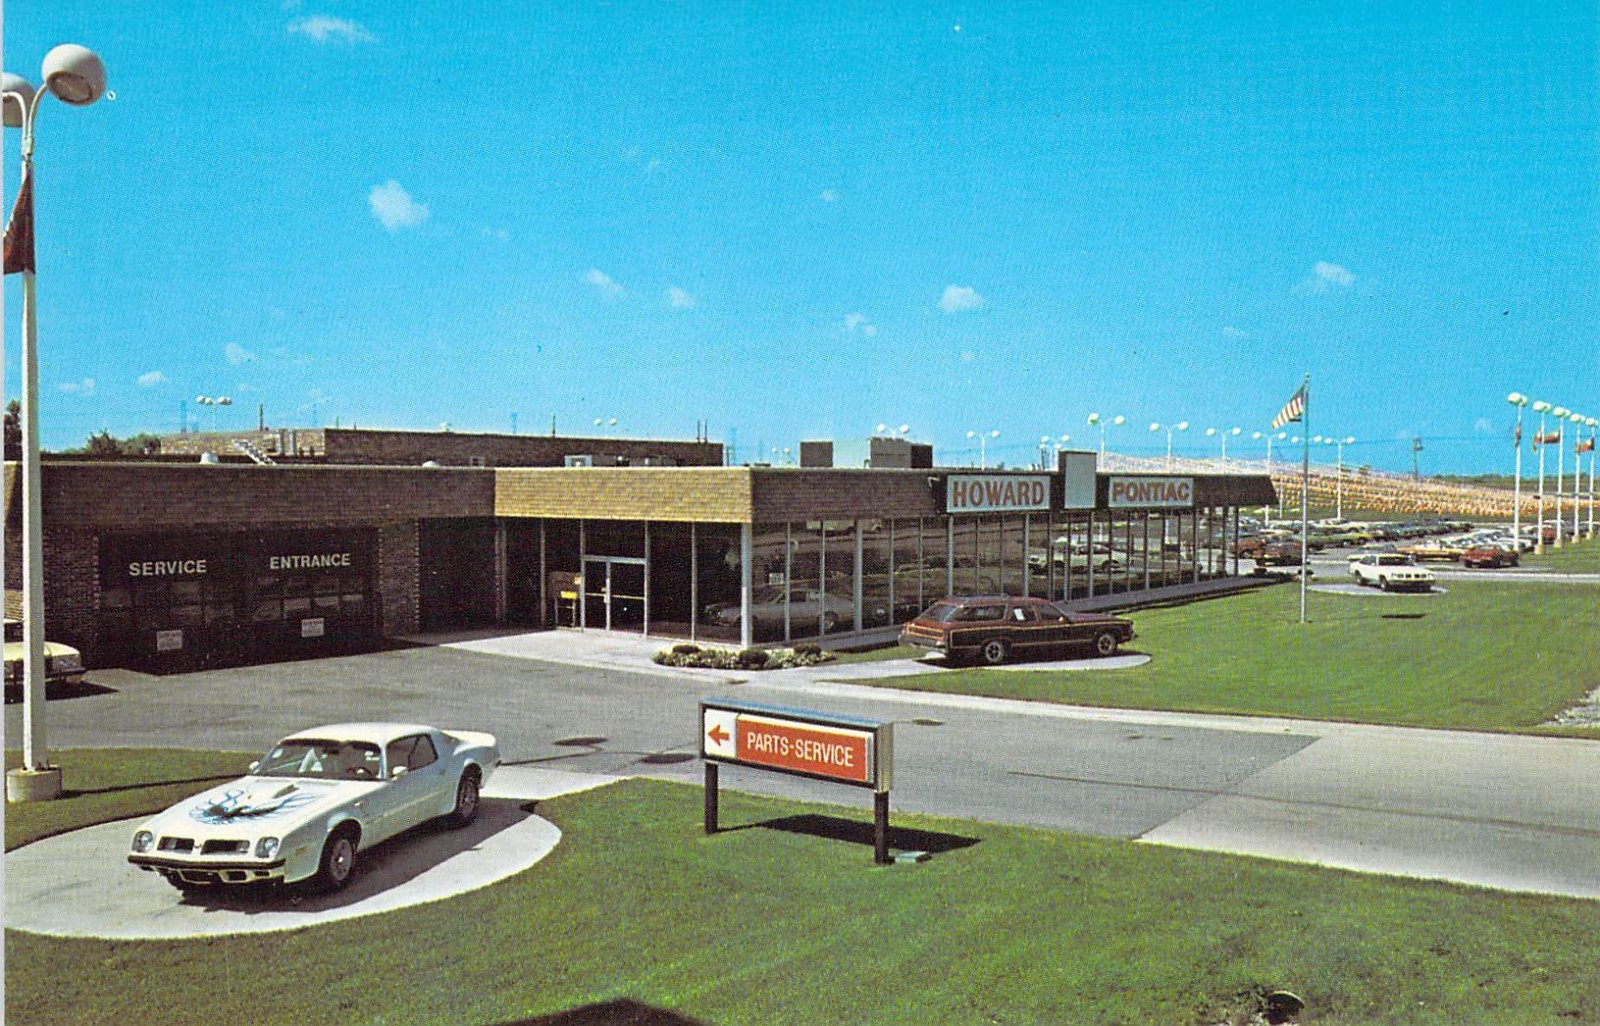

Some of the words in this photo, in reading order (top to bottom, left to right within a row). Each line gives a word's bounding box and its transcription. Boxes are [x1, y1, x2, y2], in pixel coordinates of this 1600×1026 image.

[952, 480, 1045, 507] HOWARD
[1112, 481, 1190, 502] PONTIAC
[128, 559, 207, 576] SERVICE
[269, 553, 351, 570] ENTRANCE
[747, 732, 854, 767] PARTS-SERVICE
